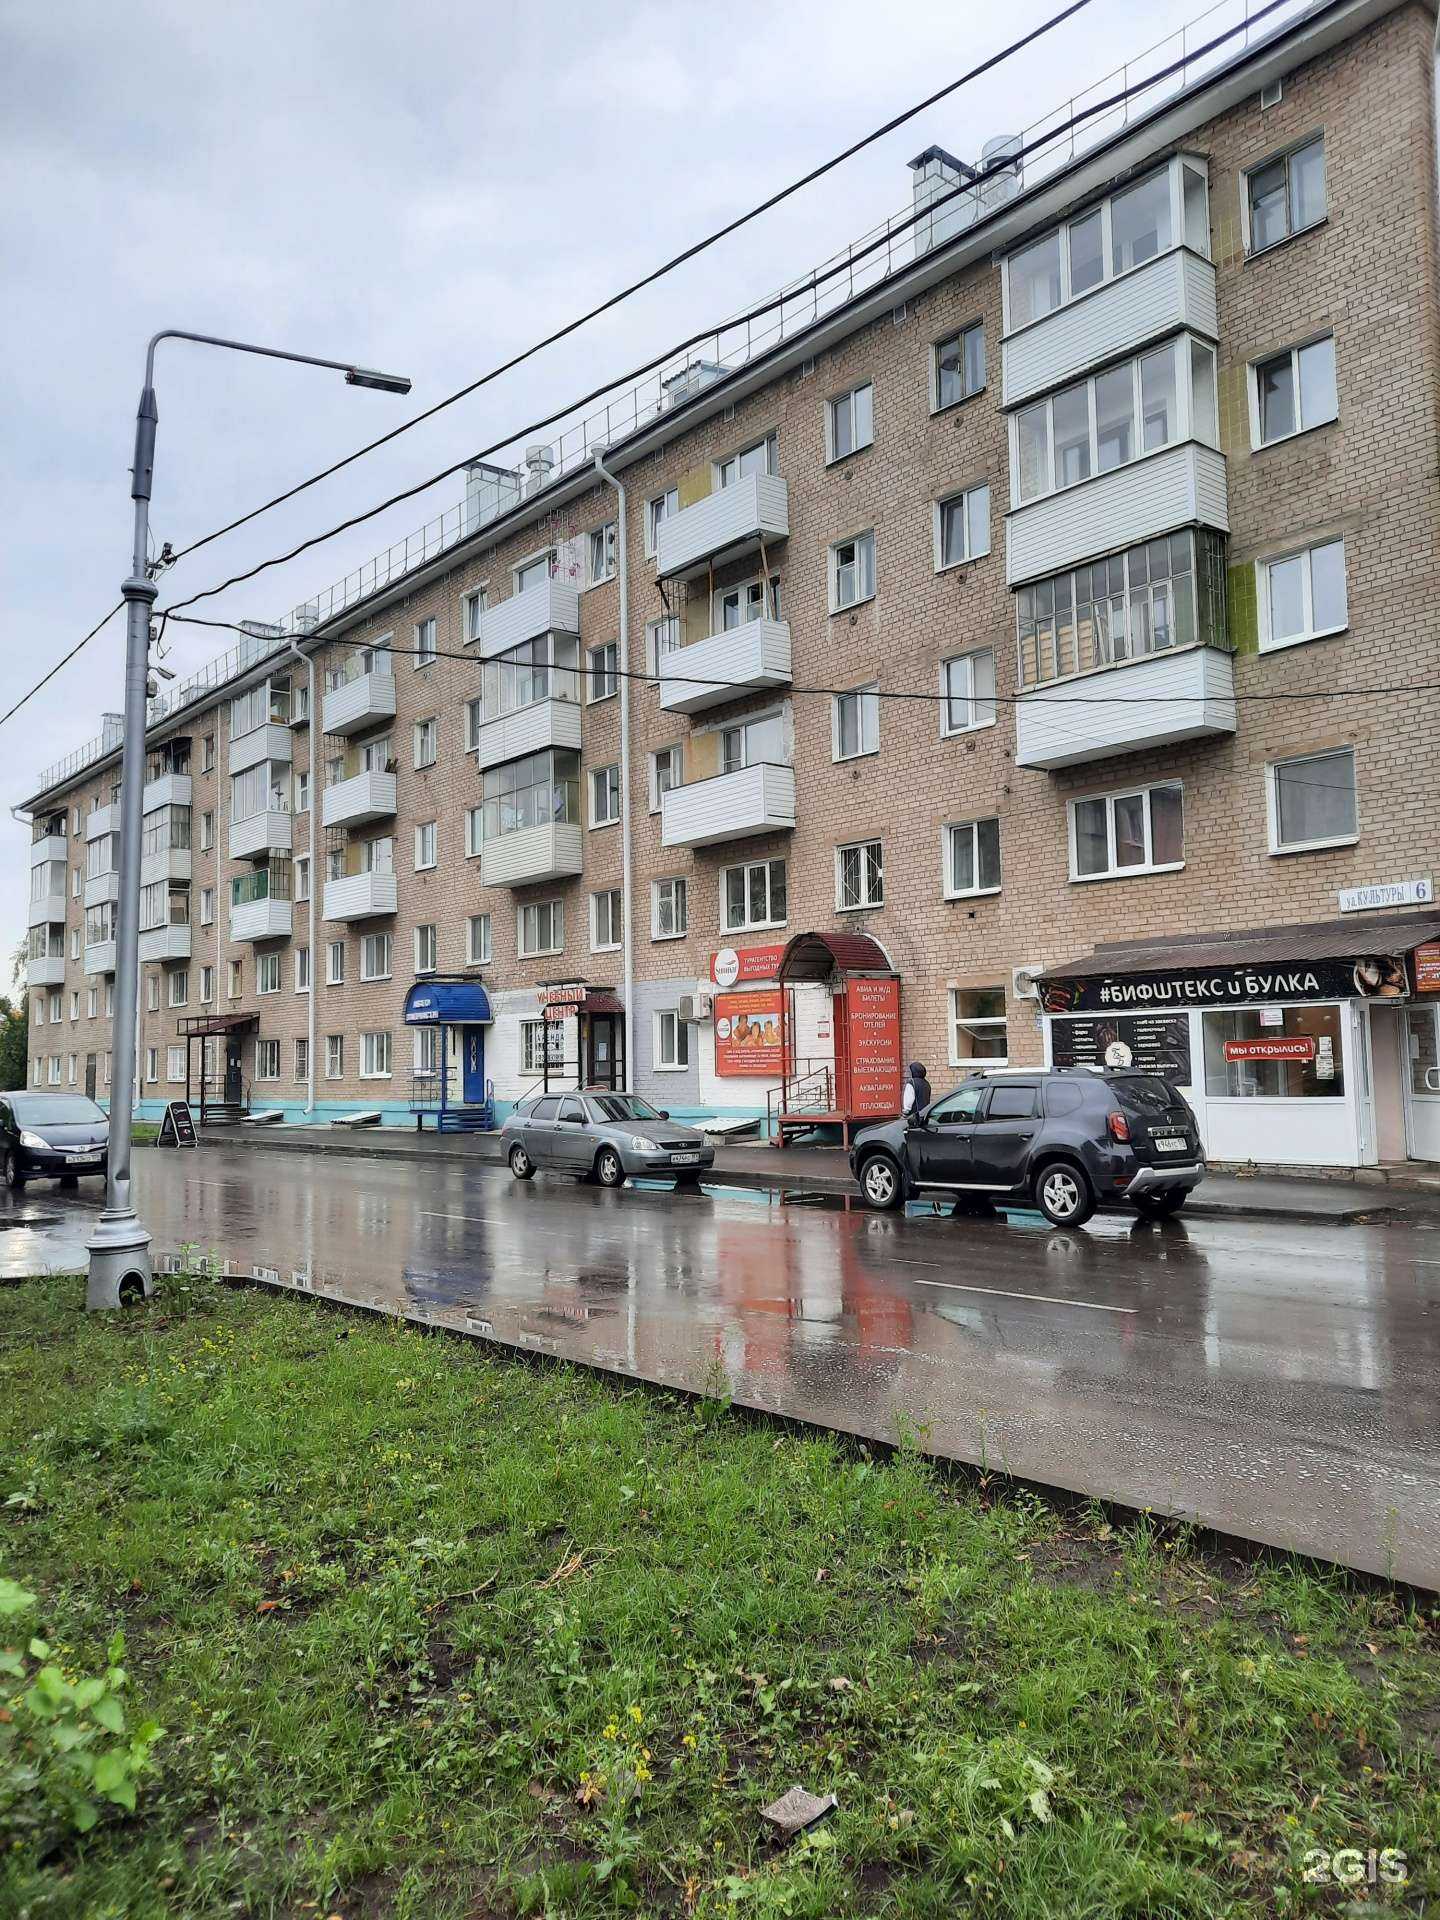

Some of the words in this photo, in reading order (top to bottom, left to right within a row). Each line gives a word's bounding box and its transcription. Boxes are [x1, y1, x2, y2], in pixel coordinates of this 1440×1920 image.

[1357, 886, 1405, 906] КУЛЬТУРЫ
[1416, 882, 1426, 899] 6
[856, 985, 873, 993] АВИА
[1100, 978, 1224, 1003] #БИФШТЕКС
[1227, 979, 1241, 990] и
[1246, 972, 1320, 994] БУЛКА
[862, 994, 886, 1002] БИЛЕТЫ
[545, 1005, 576, 1021] ЦЕНТР
[851, 1012, 897, 1020] БРОНИРОВАНИЕ
[863, 1020, 886, 1029] ОТЕЛЕЙ
[858, 1039, 893, 1047] ЭКСКУРСИИ
[1230, 1046, 1248, 1055] мы
[1249, 1043, 1309, 1056] открылись!
[855, 1057, 895, 1065] СТРАХОВАНИЕ
[860, 1083, 894, 1091] АКВАПАРКИ
[860, 1101, 895, 1110] ТЕПЛОХОДЫ
